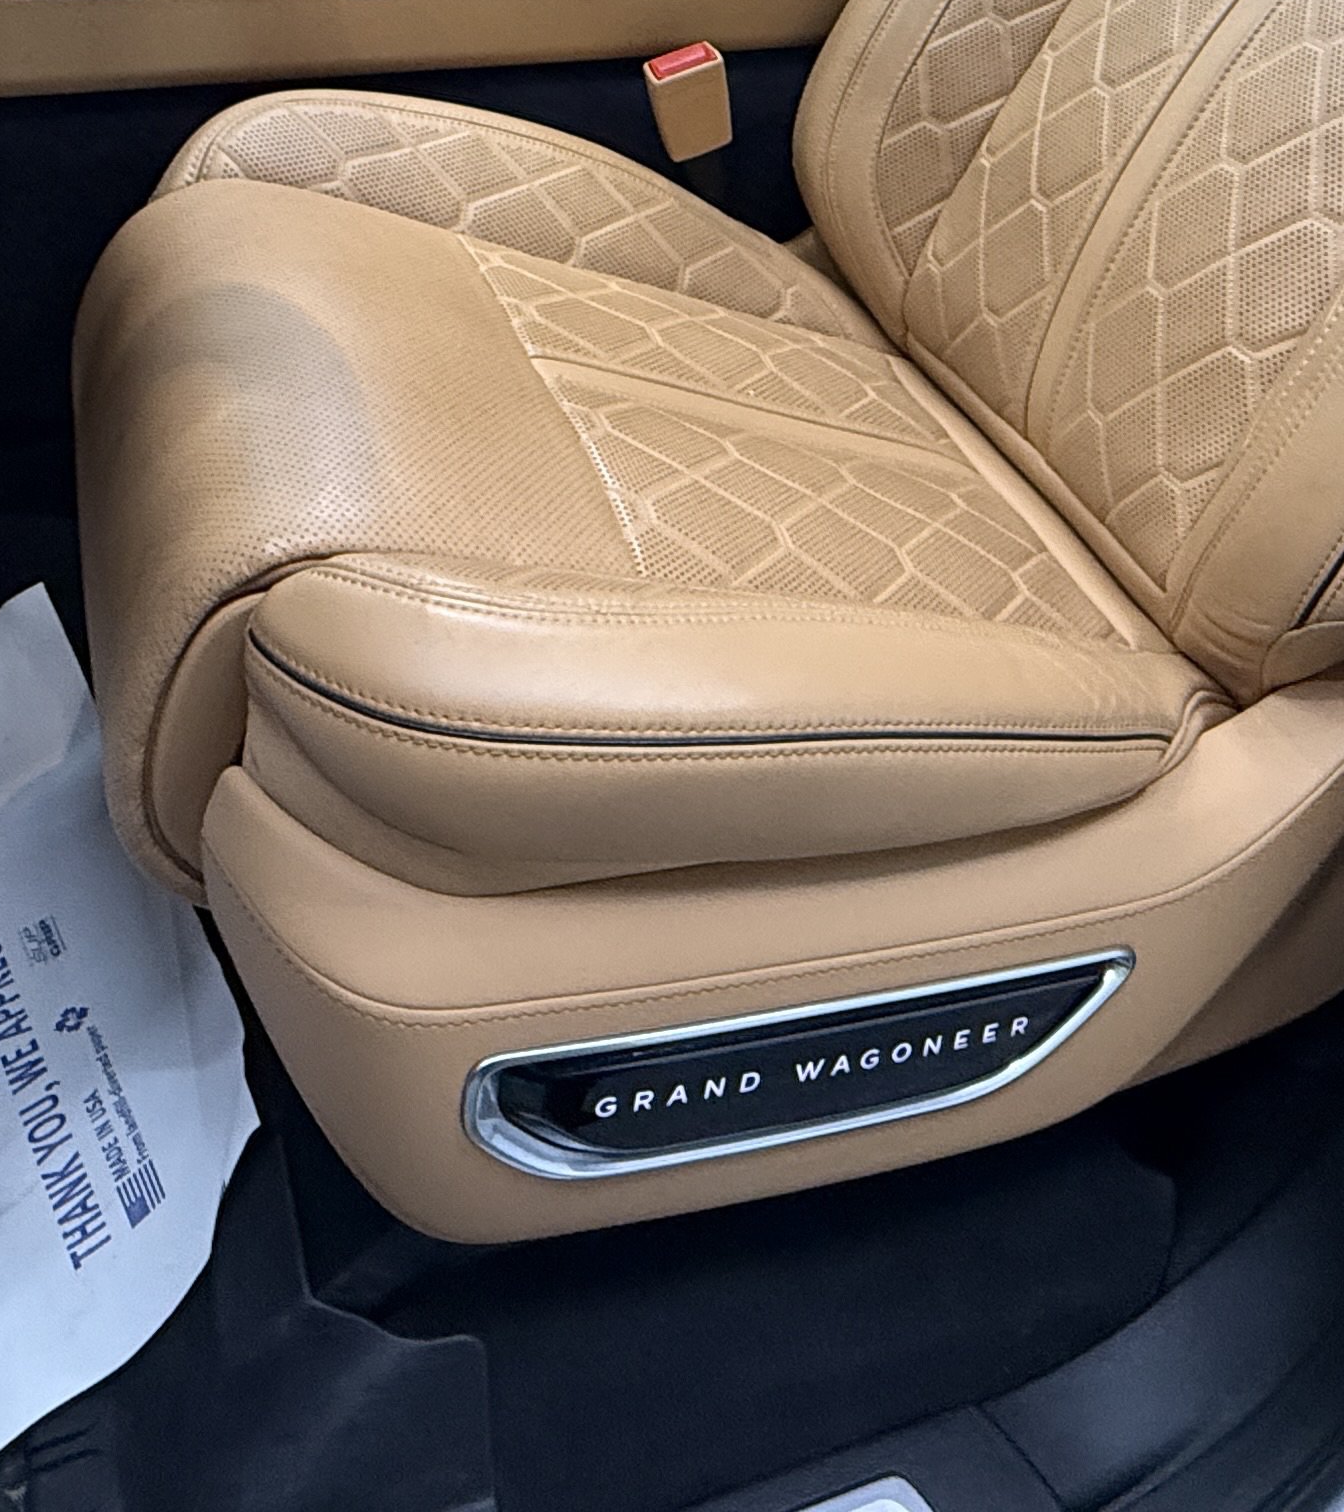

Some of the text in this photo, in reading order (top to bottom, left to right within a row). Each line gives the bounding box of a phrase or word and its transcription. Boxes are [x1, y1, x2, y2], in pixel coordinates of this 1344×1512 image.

[0, 1039, 48, 1095] WE
[595, 1015, 1029, 1118] GRAND WAGONEER
[19, 1080, 73, 1166] YOU,
[83, 1088, 131, 1182] MADE IN USA
[41, 1152, 111, 1270] THANK
